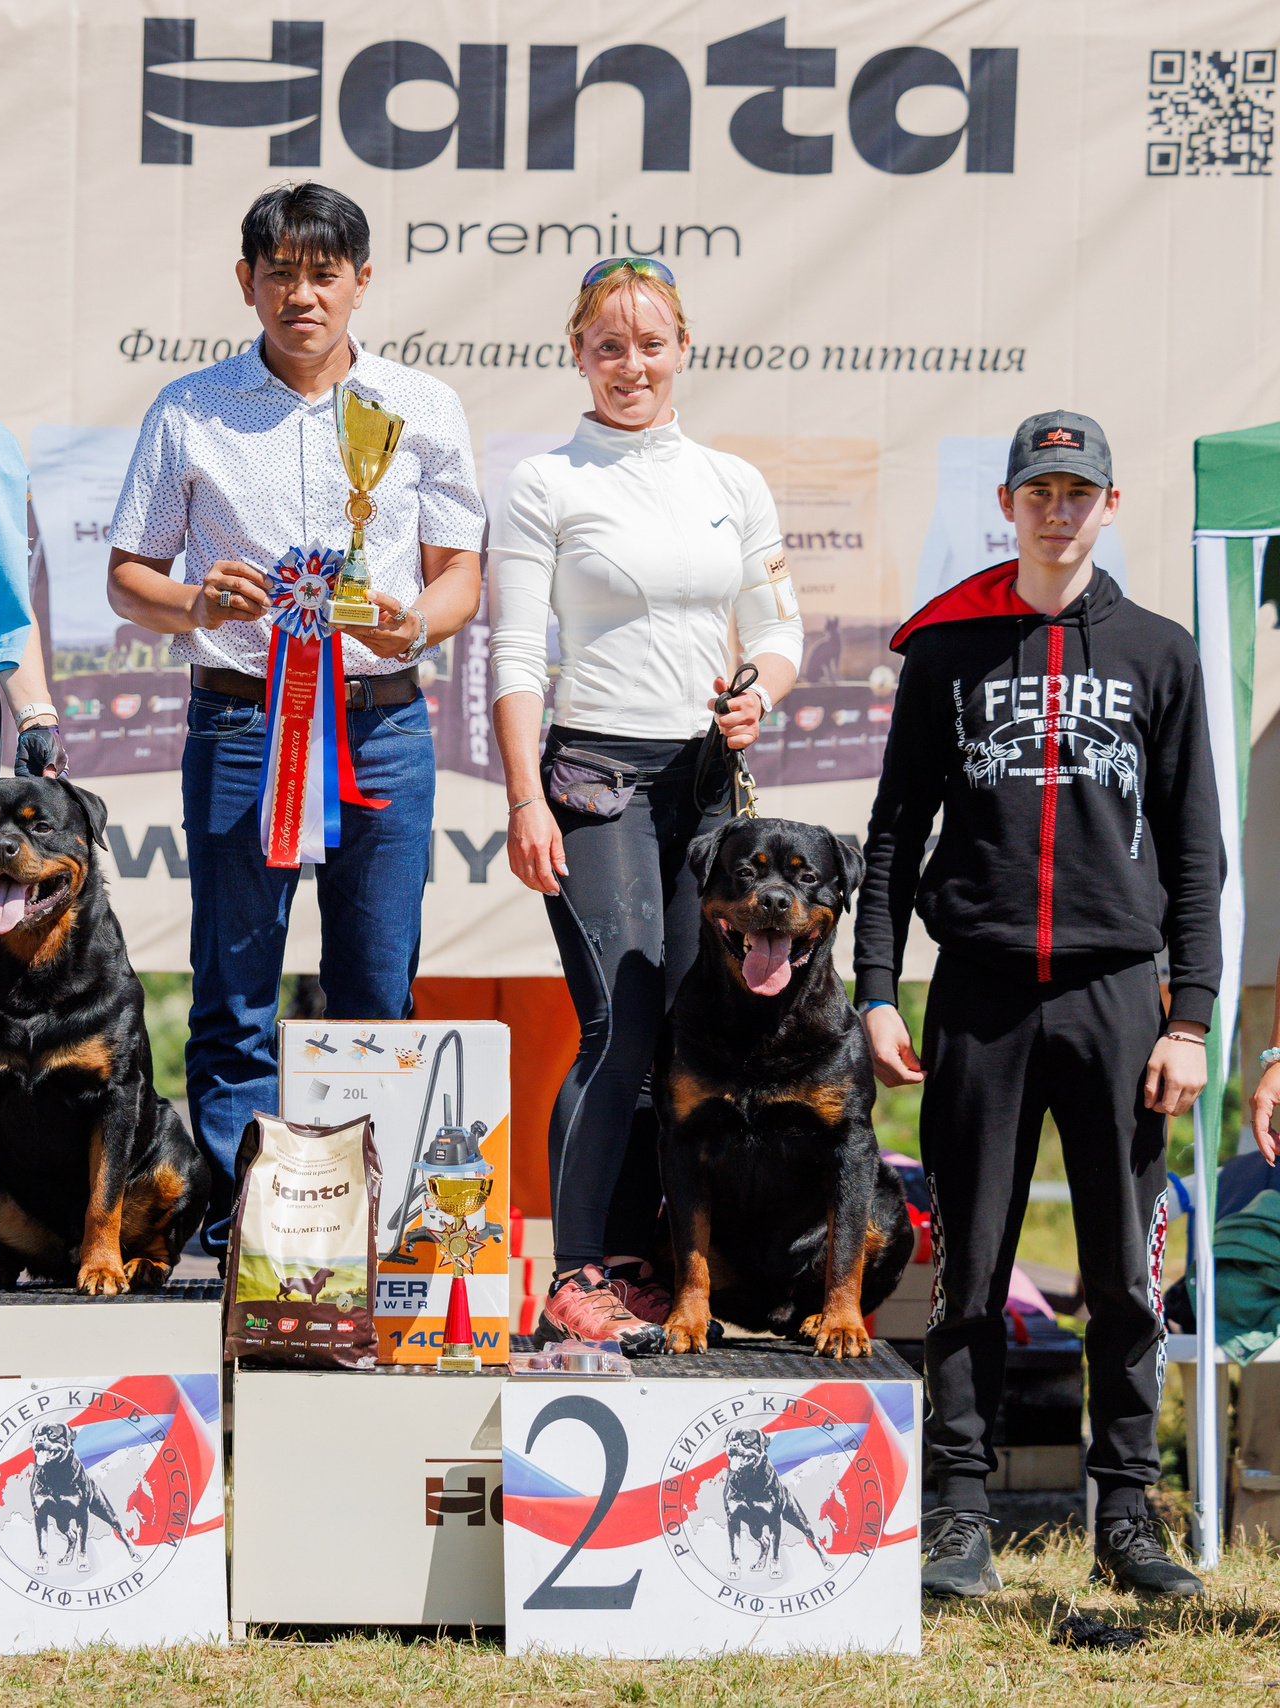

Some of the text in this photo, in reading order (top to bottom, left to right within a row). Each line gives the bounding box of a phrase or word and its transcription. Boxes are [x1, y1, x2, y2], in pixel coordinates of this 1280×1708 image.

[141, 16, 1019, 176] Hanta
[406, 212, 743, 264] premium
[822, 344, 1027, 373] питания
[784, 530, 864, 550] anta
[468, 624, 490, 766] Hanta
[984, 674, 1133, 722] FERRE
[278, 730, 301, 856] Победитель класса
[1130, 819, 1142, 860] LIMITED
[343, 1088, 368, 1100] 20L
[270, 1222, 341, 1235] SMALL/MEDIUM
[68, 1390, 141, 1424] КЛУБ
[150, 1429, 188, 1548] РОССИИ
[663, 1396, 880, 1558] РОТВЕЙЛЕР КЛУБ РОССИИ
[522, 1394, 643, 1610] 2
[25, 1572, 144, 1607] РКФ-НКПР
[717, 1580, 837, 1614] РКФ-НКПР
